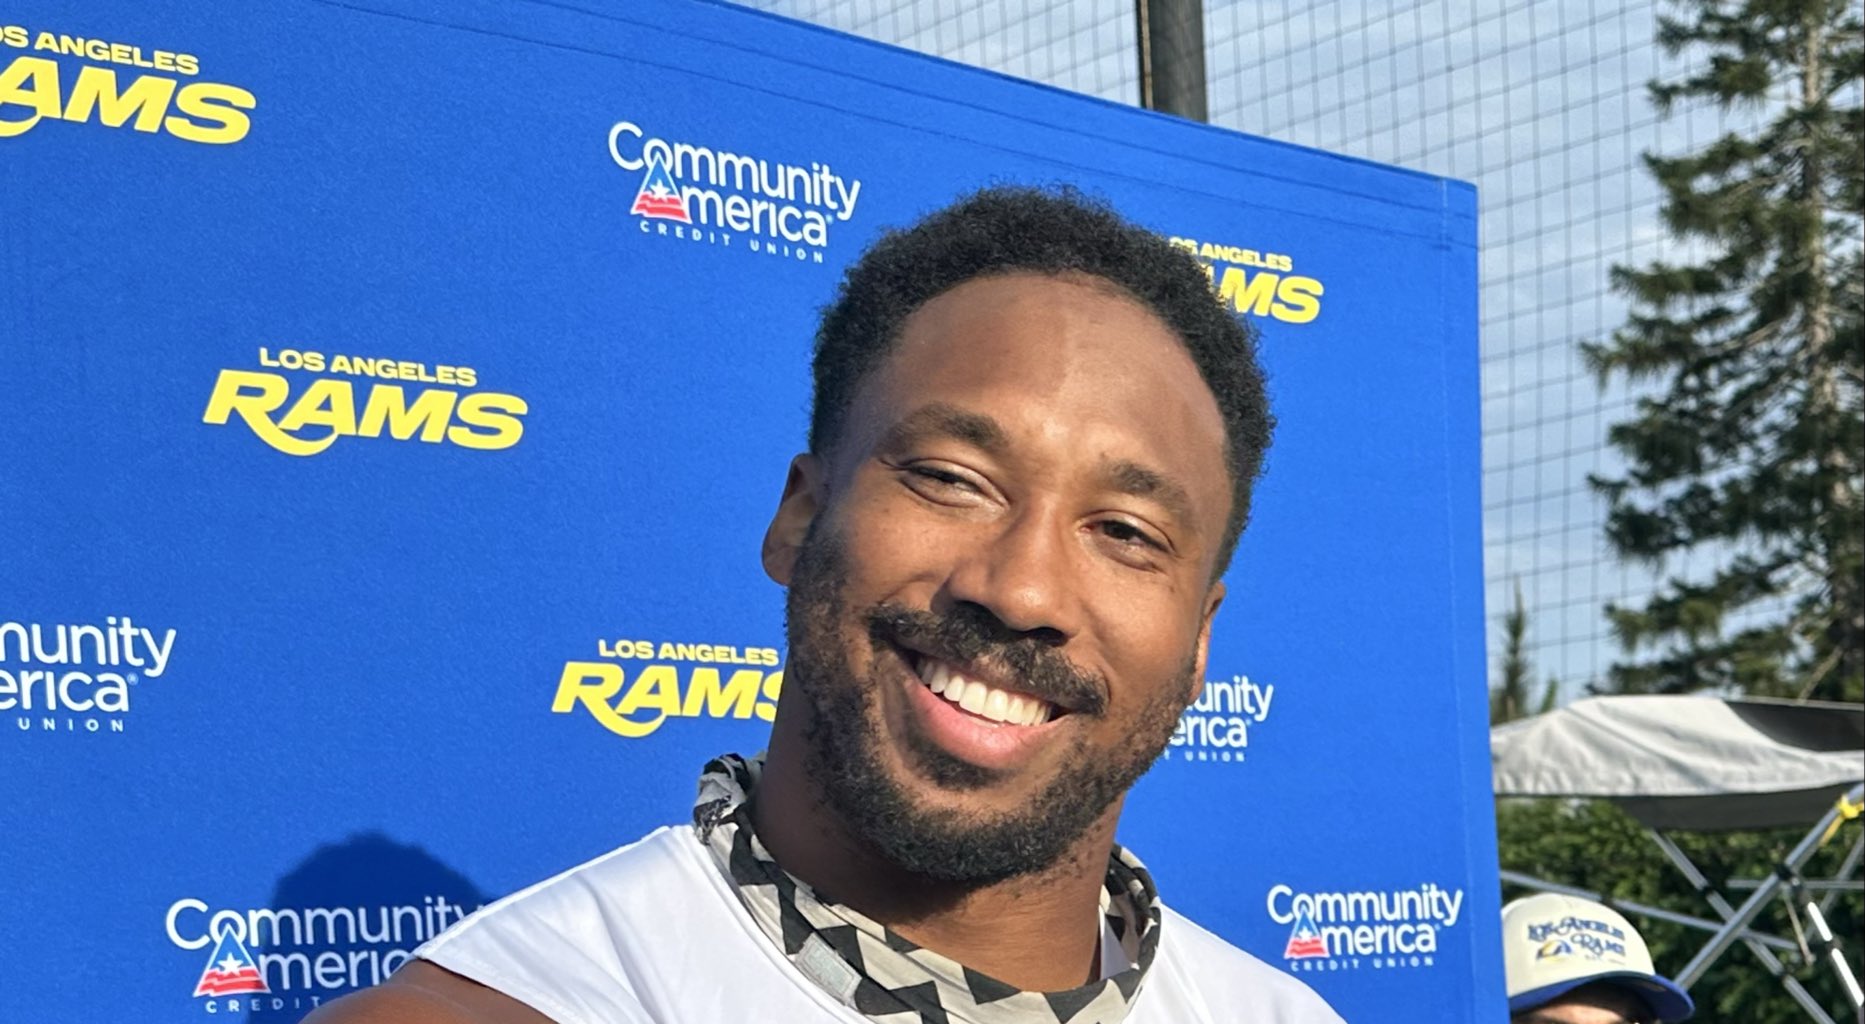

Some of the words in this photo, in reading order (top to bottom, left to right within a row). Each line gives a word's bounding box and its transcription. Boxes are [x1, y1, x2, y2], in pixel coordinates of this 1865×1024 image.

[34, 32, 199, 75] ANGELES
[0, 56, 256, 144] AMS
[608, 121, 861, 221] Community
[640, 220, 731, 246] CREDIT
[750, 240, 823, 264] UNION
[1200, 242, 1293, 272] ANGELES
[1200, 264, 1324, 324] MS
[260, 347, 325, 371] LOS
[330, 355, 477, 387] ANGELES
[203, 369, 528, 456] RAMS
[598, 639, 654, 660] LOS
[658, 642, 779, 666] ANGELES
[1186, 675, 1273, 722] unity
[18, 717, 124, 732] UNION
[166, 896, 484, 950] Communit
[1267, 883, 1464, 926] Community
[1290, 958, 1359, 972] CREDIT
[1373, 956, 1433, 969] UNION
[205, 996, 321, 1014] CREDIT
